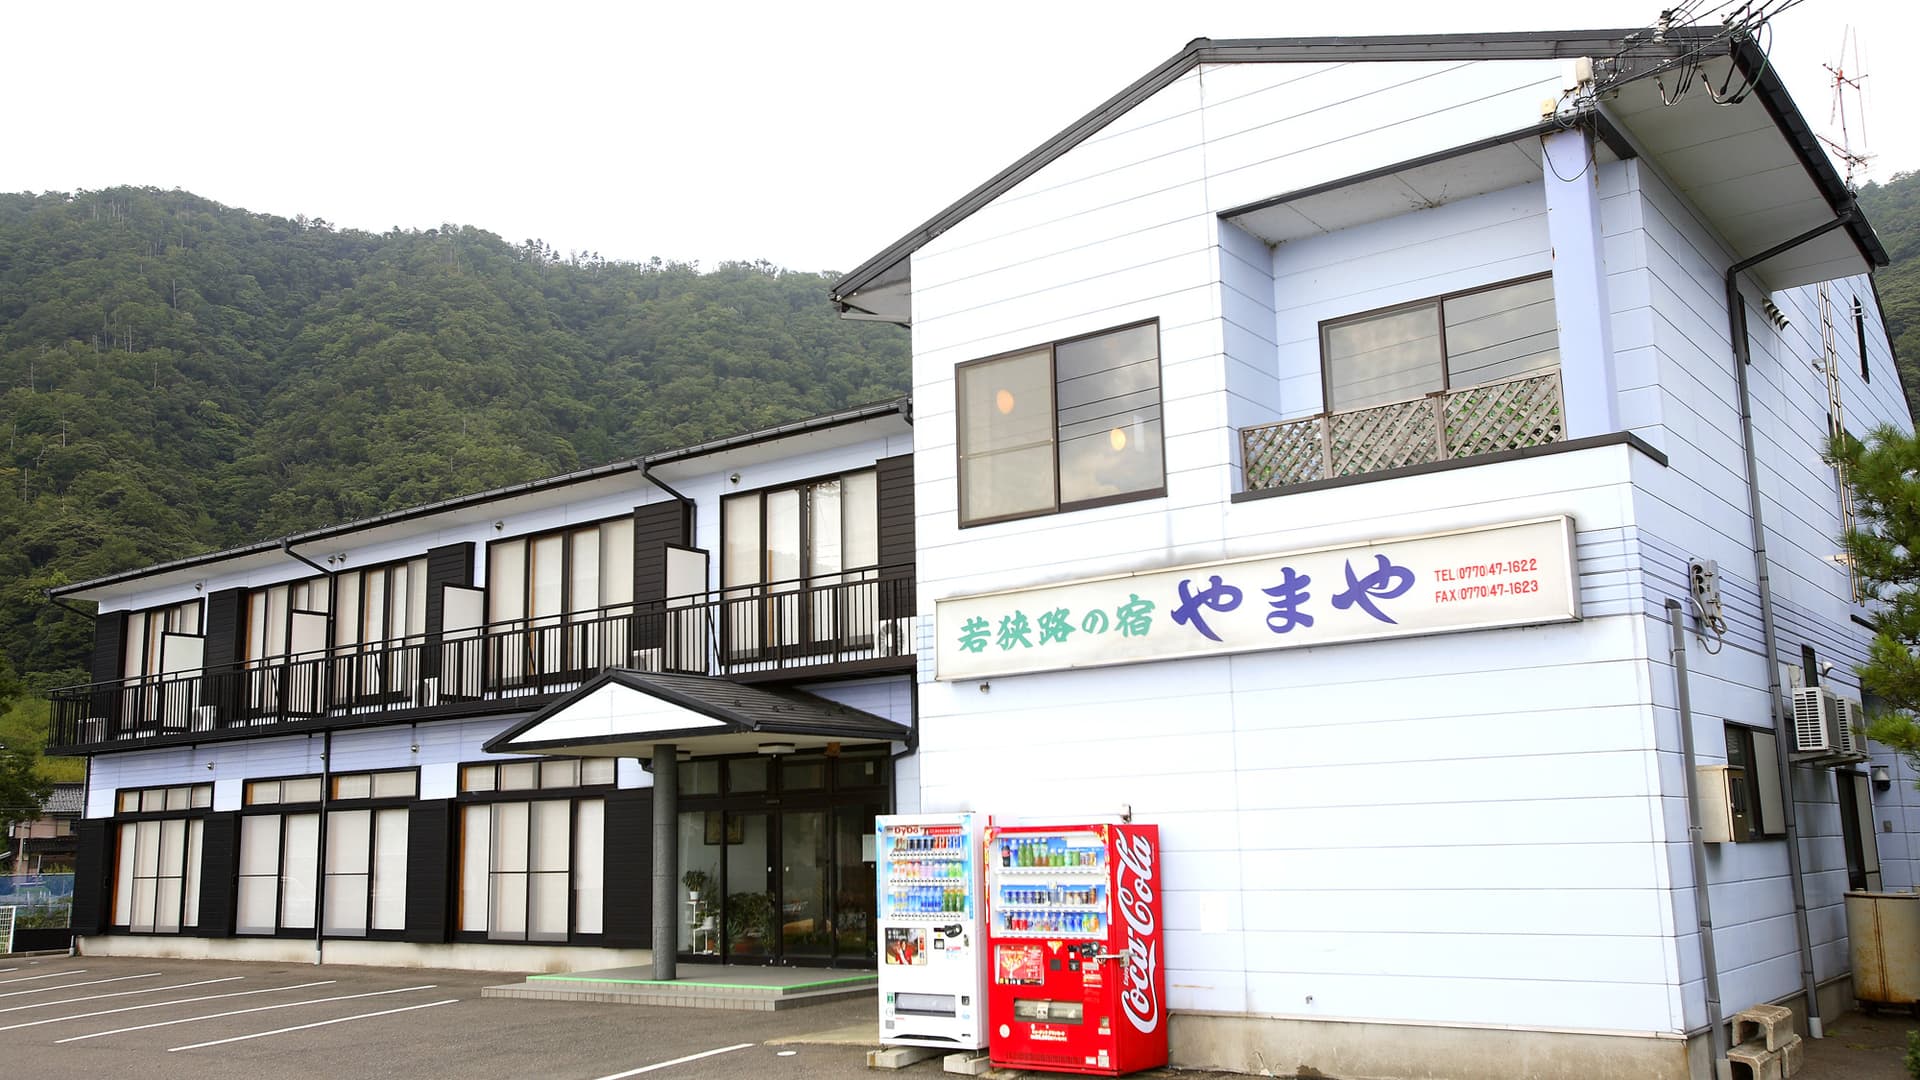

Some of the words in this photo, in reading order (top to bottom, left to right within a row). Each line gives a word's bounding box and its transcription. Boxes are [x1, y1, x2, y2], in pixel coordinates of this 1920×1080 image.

[958, 593, 1156, 653] 若狭路の宿
[1171, 554, 1416, 642] やまや
[894, 826, 919, 836] DyDo
[1116, 827, 1159, 1034] Coca-Cola
